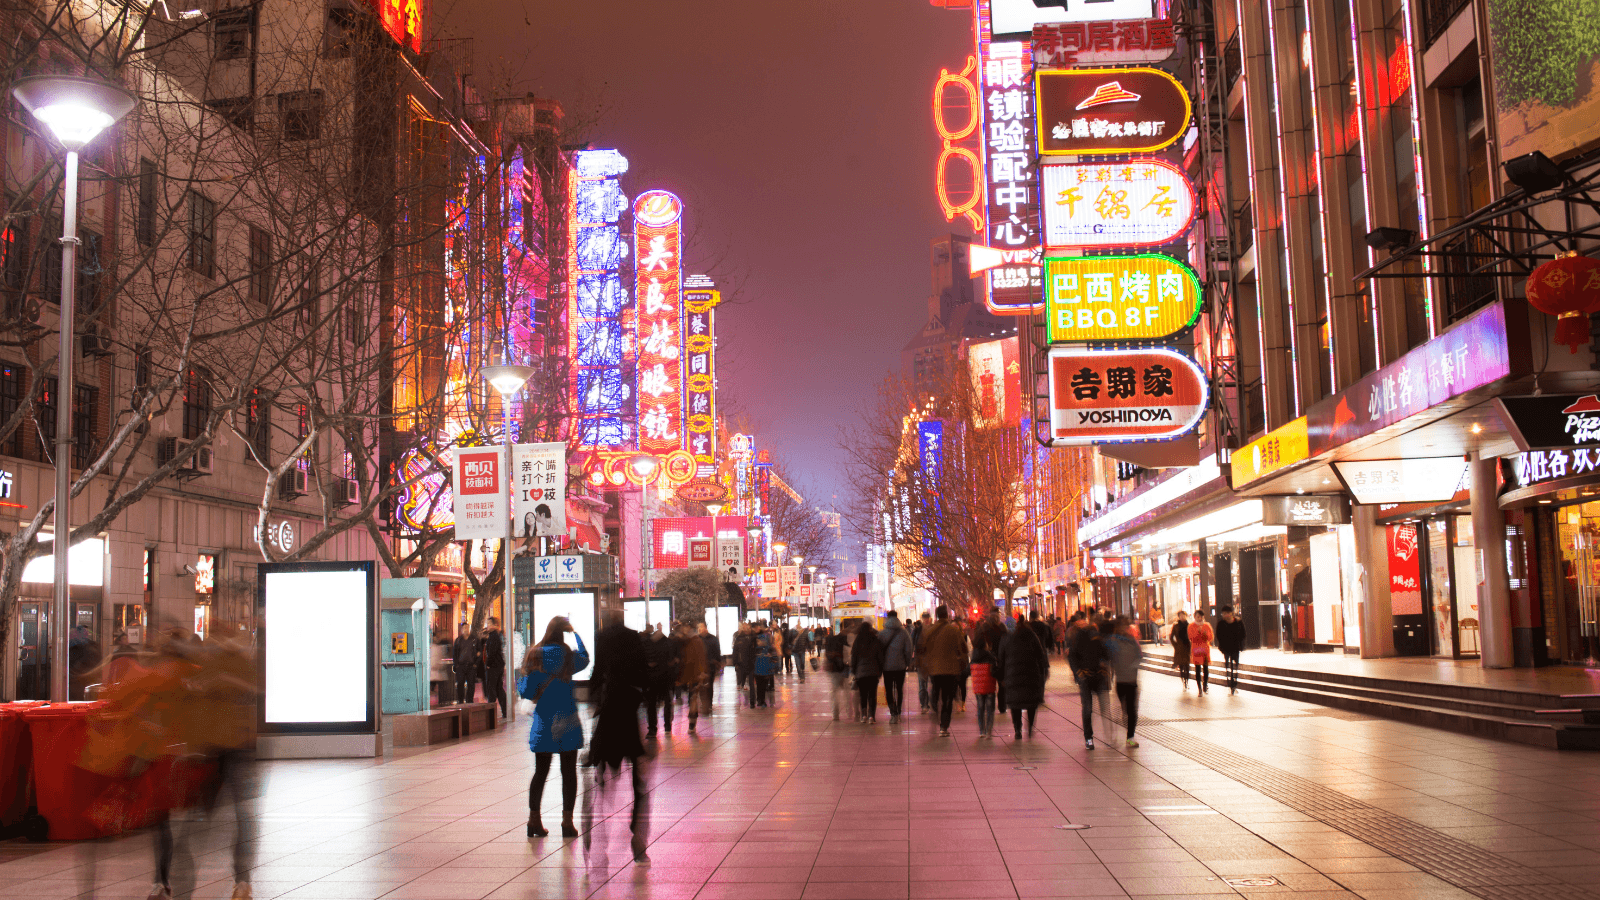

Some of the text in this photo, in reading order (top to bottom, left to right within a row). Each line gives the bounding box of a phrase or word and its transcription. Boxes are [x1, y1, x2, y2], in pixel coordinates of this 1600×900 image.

[1031, 19, 1176, 55] 寿司居酒屋
[1053, 269, 1184, 304] 巴西烤肉
[1057, 306, 1159, 329] BBQ 8F
[1070, 364, 1173, 401] 吉野家
[1078, 408, 1172, 424] YOSHINOYA
[1564, 413, 1600, 433] Pizz
[464, 461, 493, 476] 西贝
[522, 473, 556, 485] 打个折
[522, 489, 529, 501] I
